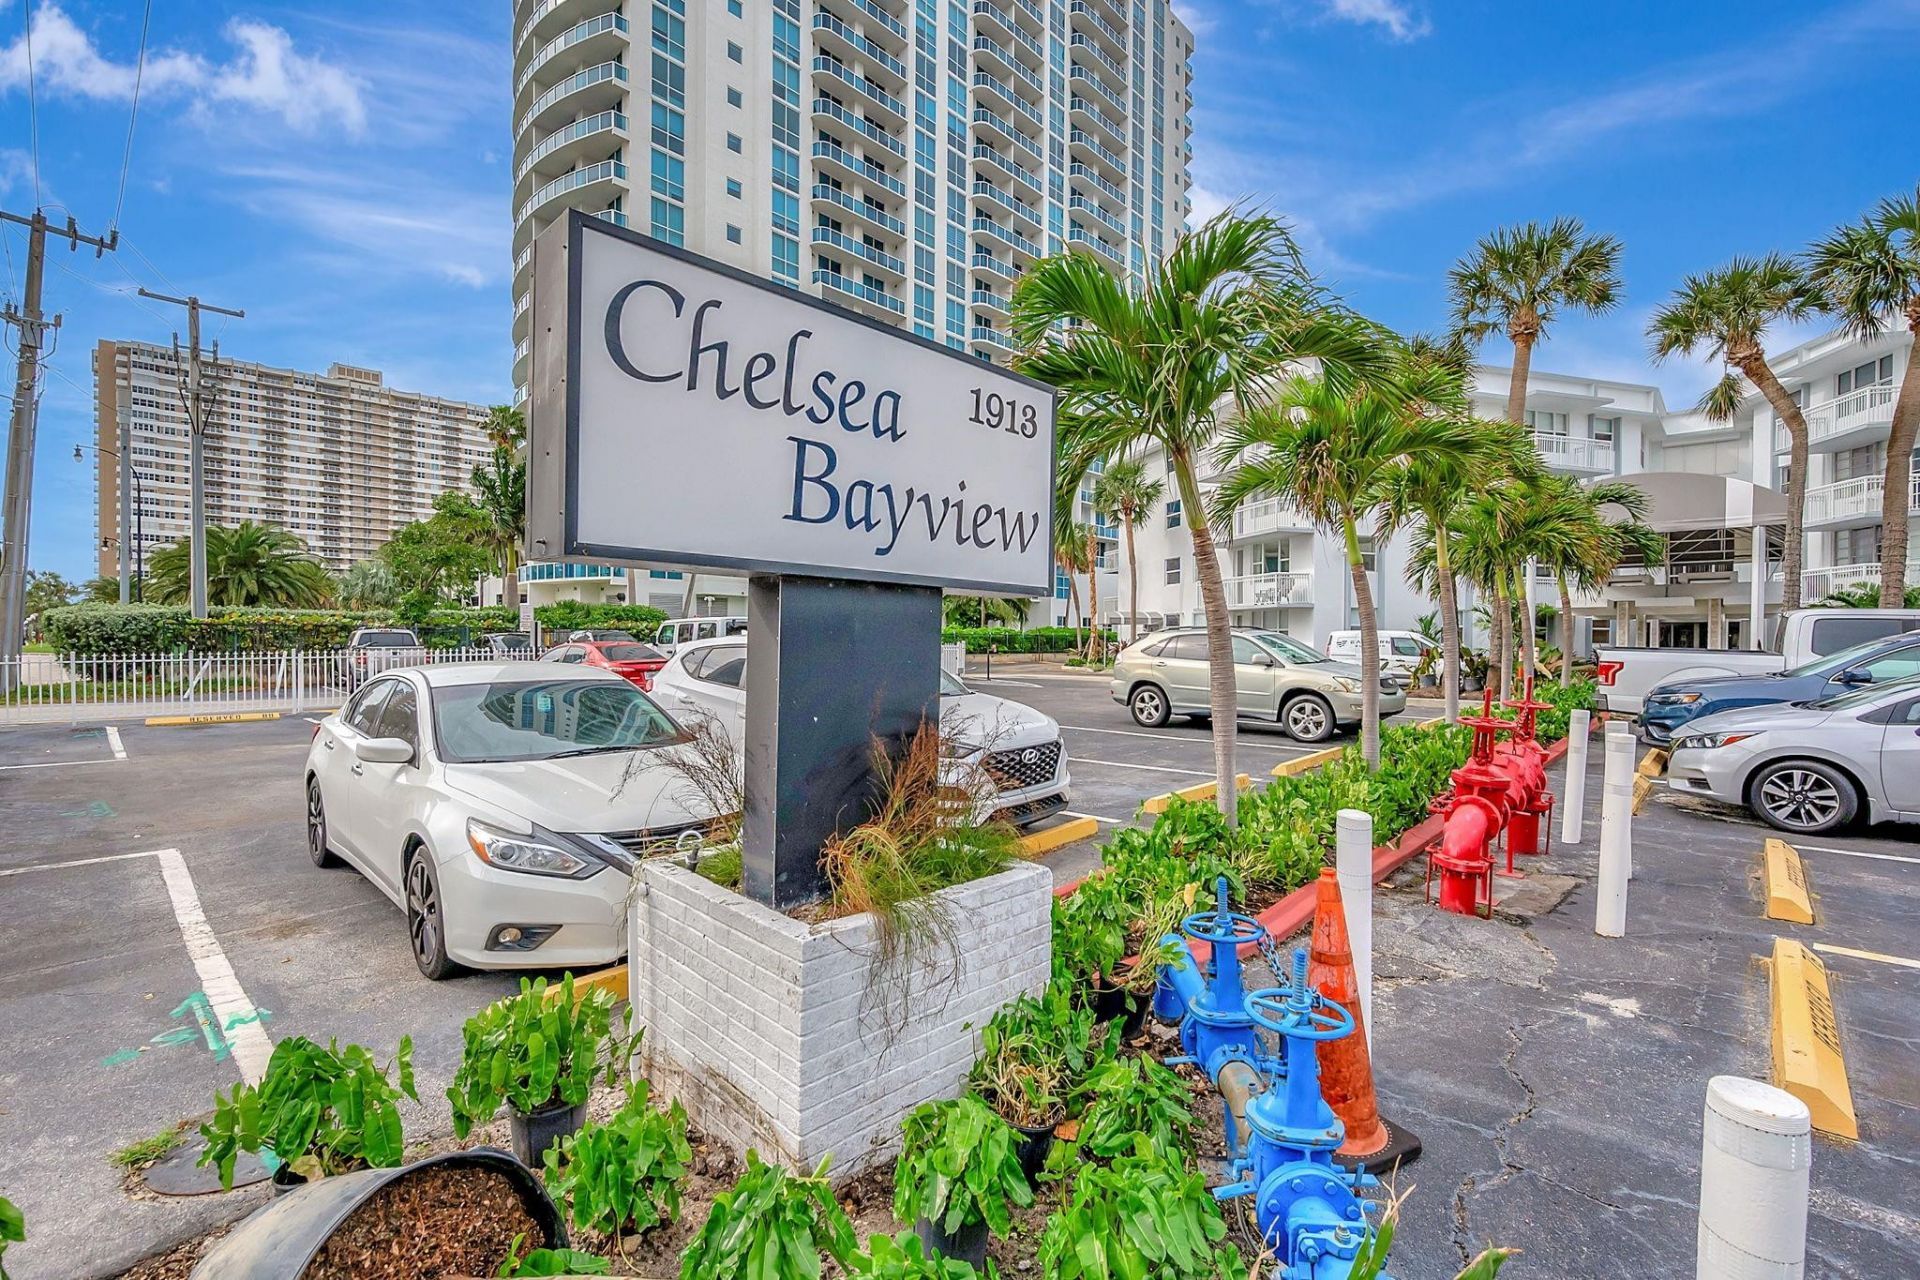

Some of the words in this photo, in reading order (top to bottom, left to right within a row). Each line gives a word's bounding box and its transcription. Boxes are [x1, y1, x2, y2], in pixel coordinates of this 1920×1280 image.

[604, 280, 907, 442] Chelsea
[968, 388, 1038, 439] 1913
[782, 436, 1040, 556] Bayview
